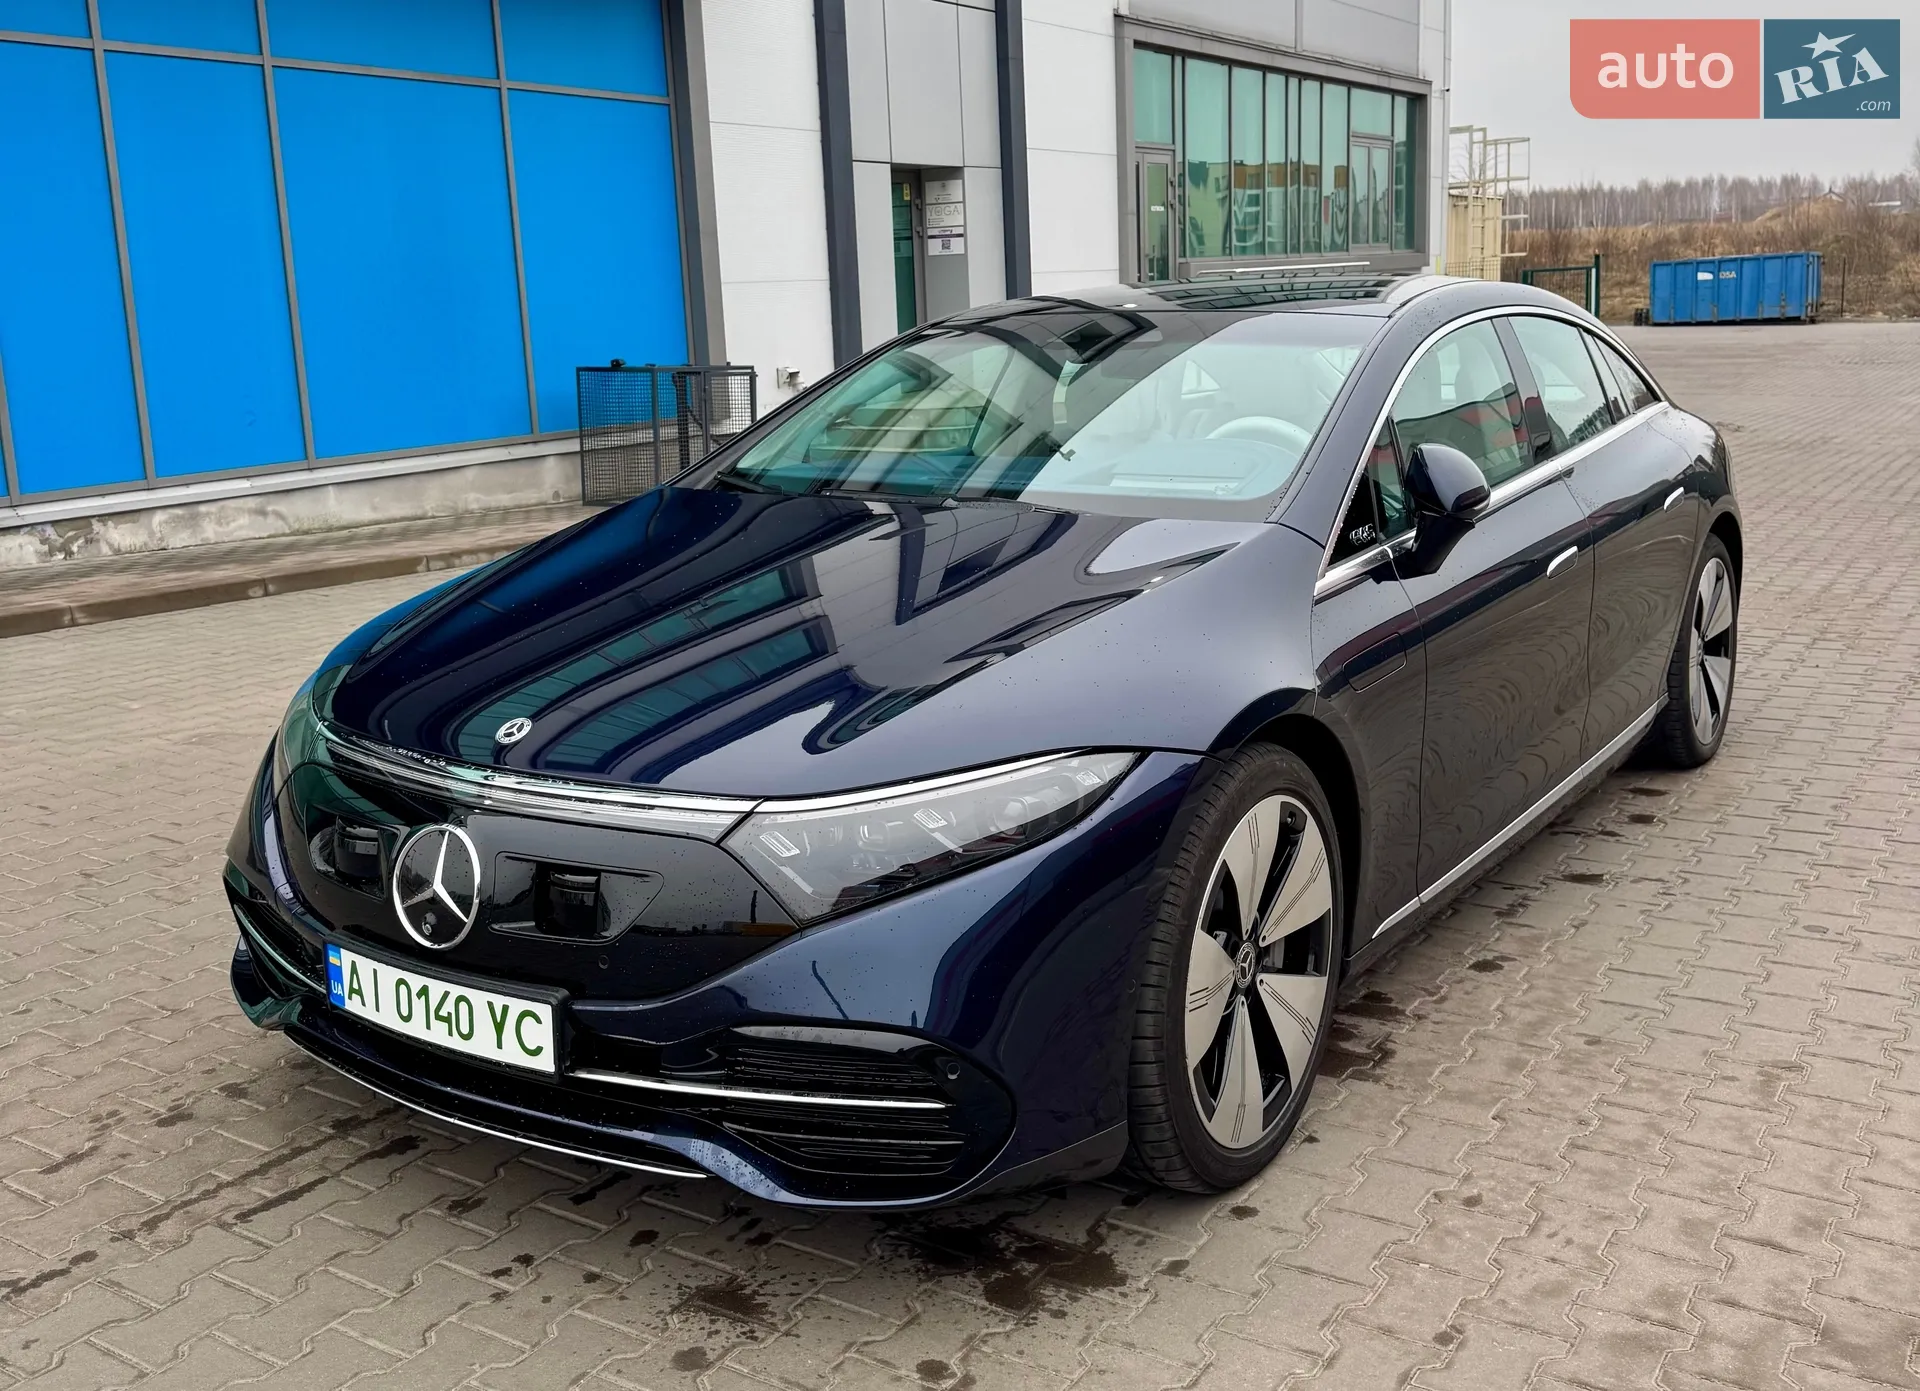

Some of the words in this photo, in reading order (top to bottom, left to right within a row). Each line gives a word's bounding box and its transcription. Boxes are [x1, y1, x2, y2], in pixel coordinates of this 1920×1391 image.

[927, 205, 961, 217] YOGA
[331, 979, 344, 998] UA
[347, 960, 380, 1013] AI
[394, 977, 475, 1042] 0140
[486, 1000, 544, 1058] YC
